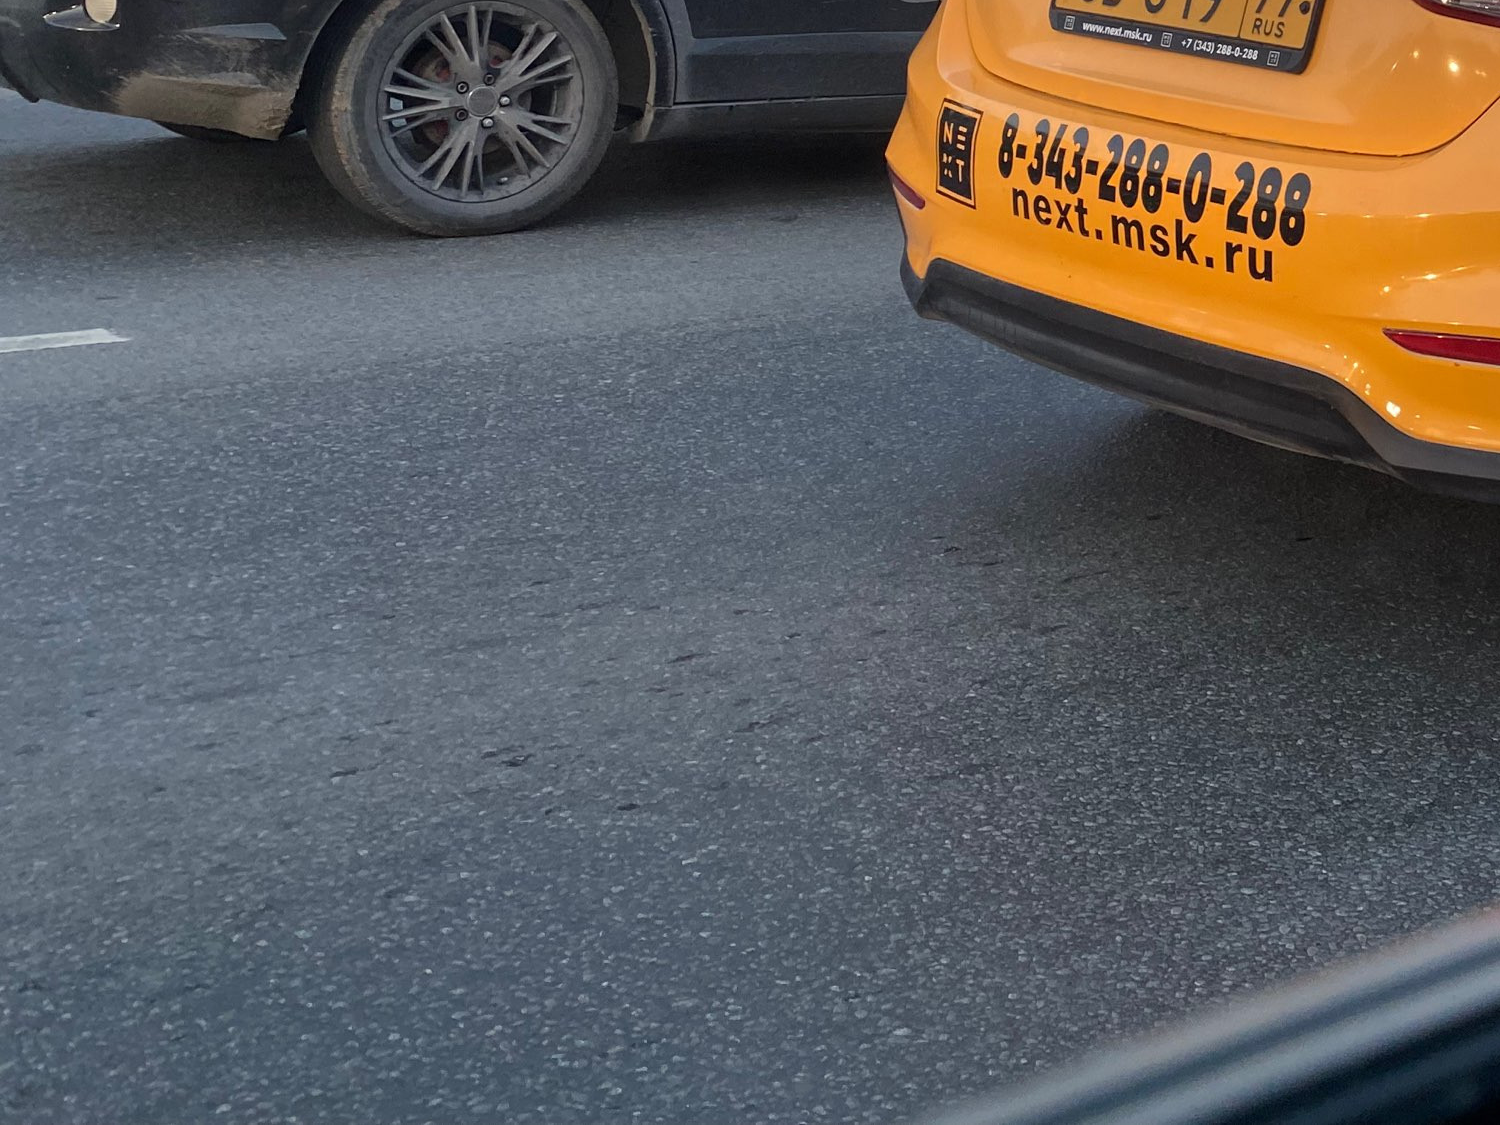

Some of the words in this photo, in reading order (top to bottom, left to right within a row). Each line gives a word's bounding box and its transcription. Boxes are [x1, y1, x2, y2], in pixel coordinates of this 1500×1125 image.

[1082, 21, 1153, 42] www.next.msk.ru
[1251, 17, 1286, 39] RUS
[1181, 38, 1192, 49] +7
[1193, 39, 1215, 55] (343)
[1216, 42, 1259, 60] 288-0-288
[998, 112, 1312, 247] 8-343-288-0-288
[1012, 186, 1274, 283] next.msk.ru
